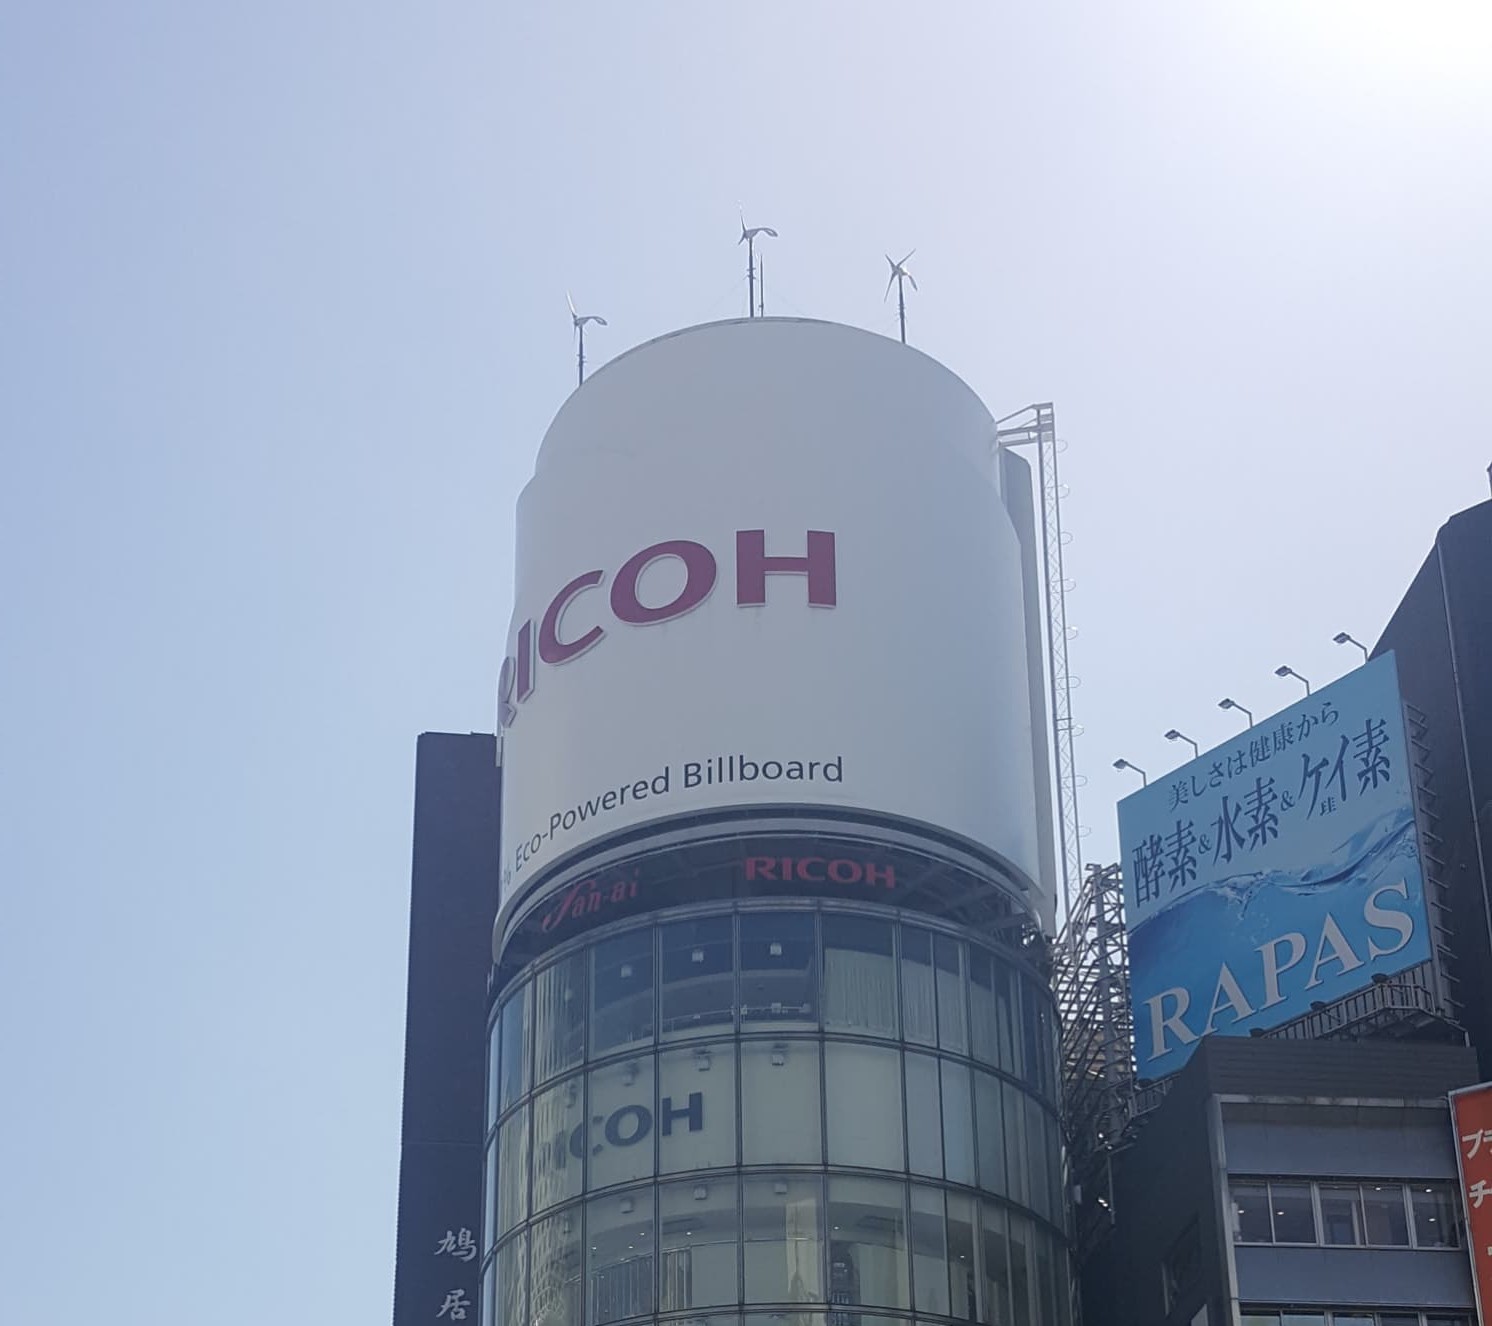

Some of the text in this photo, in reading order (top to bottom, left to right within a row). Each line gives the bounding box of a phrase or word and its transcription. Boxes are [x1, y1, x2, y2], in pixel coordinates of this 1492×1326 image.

[1169, 702, 1339, 810] 美しさは健康から
[514, 766, 670, 871] Eco-Powered
[684, 755, 844, 789] Billboard
[744, 857, 896, 887] RICOH
[1144, 879, 1414, 1062] RAPAS
[541, 1092, 703, 1170] ICOH
